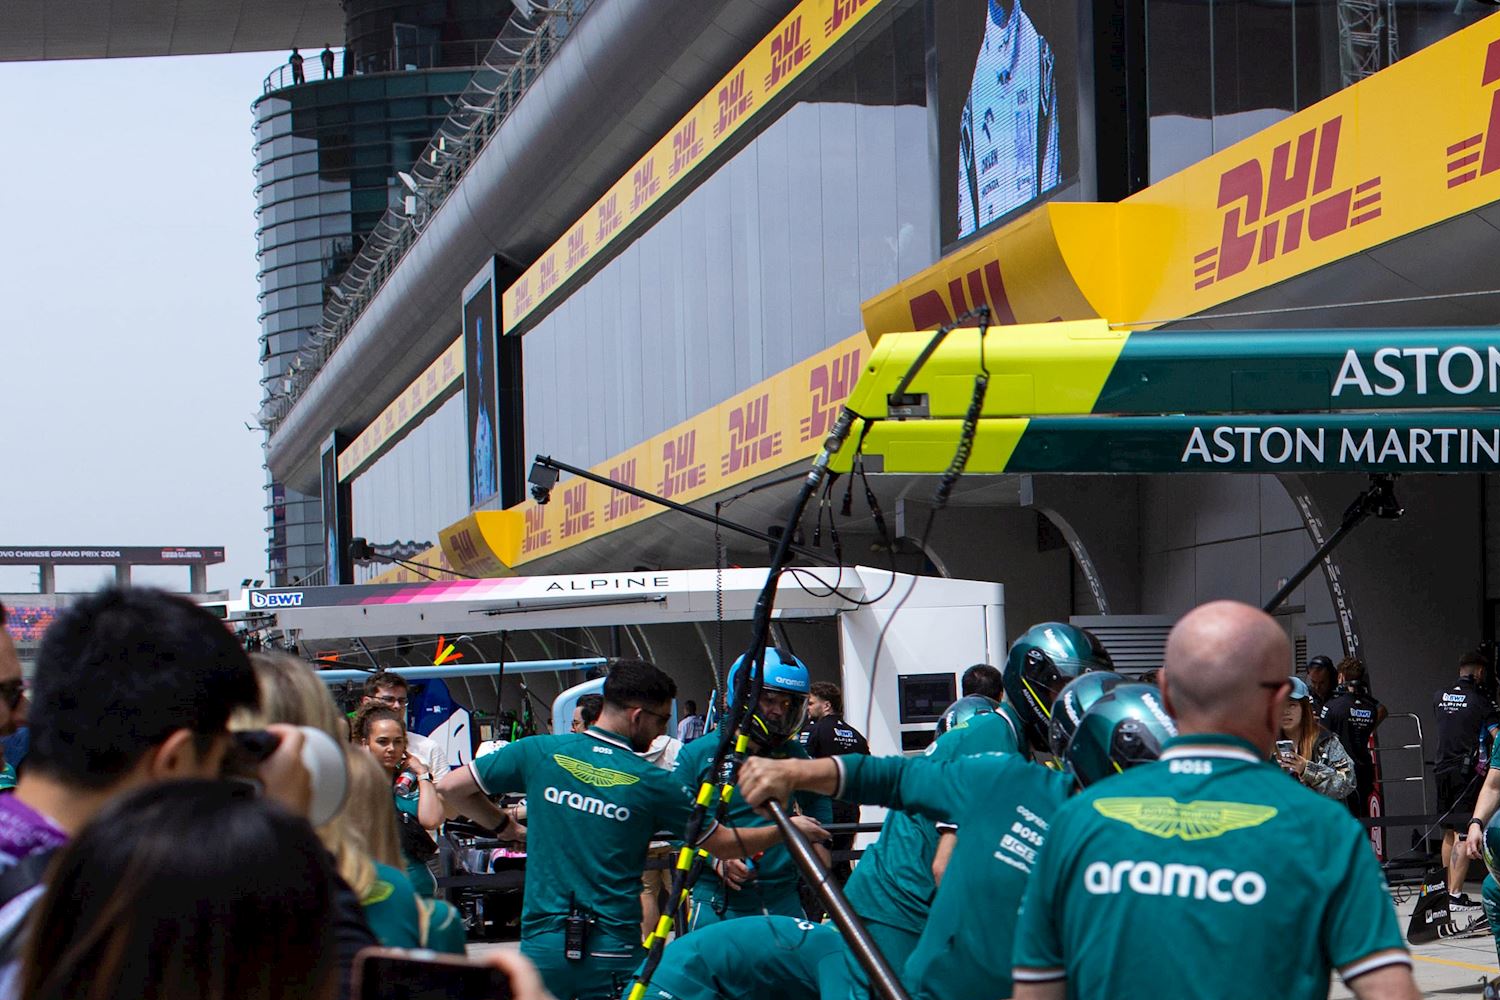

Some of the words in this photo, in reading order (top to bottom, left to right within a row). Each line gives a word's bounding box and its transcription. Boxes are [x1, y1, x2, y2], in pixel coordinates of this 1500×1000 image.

[769, 15, 806, 88] DHL
[717, 70, 747, 134] DHL
[671, 117, 698, 177] DHL
[633, 156, 656, 212] DHL
[1217, 116, 1352, 282] DHL
[729, 394, 774, 475] DHL
[1182, 425, 1326, 464] ASTON
[1338, 427, 1500, 464] MARTIN
[662, 430, 699, 498] DHL
[563, 482, 590, 538] DHL
[15, 550, 50, 558] CHINESE
[51, 550, 80, 558] GRAND
[81, 550, 100, 558] PRIX
[100, 550, 121, 558] 2024
[267, 593, 303, 606] BWT
[546, 576, 670, 592] ALPINE
[592, 746, 613, 754] BOSS
[1169, 759, 1212, 774] BOSS
[544, 787, 631, 822] aramco
[1011, 822, 1045, 846] BOSS
[1084, 859, 1267, 906] aramco
